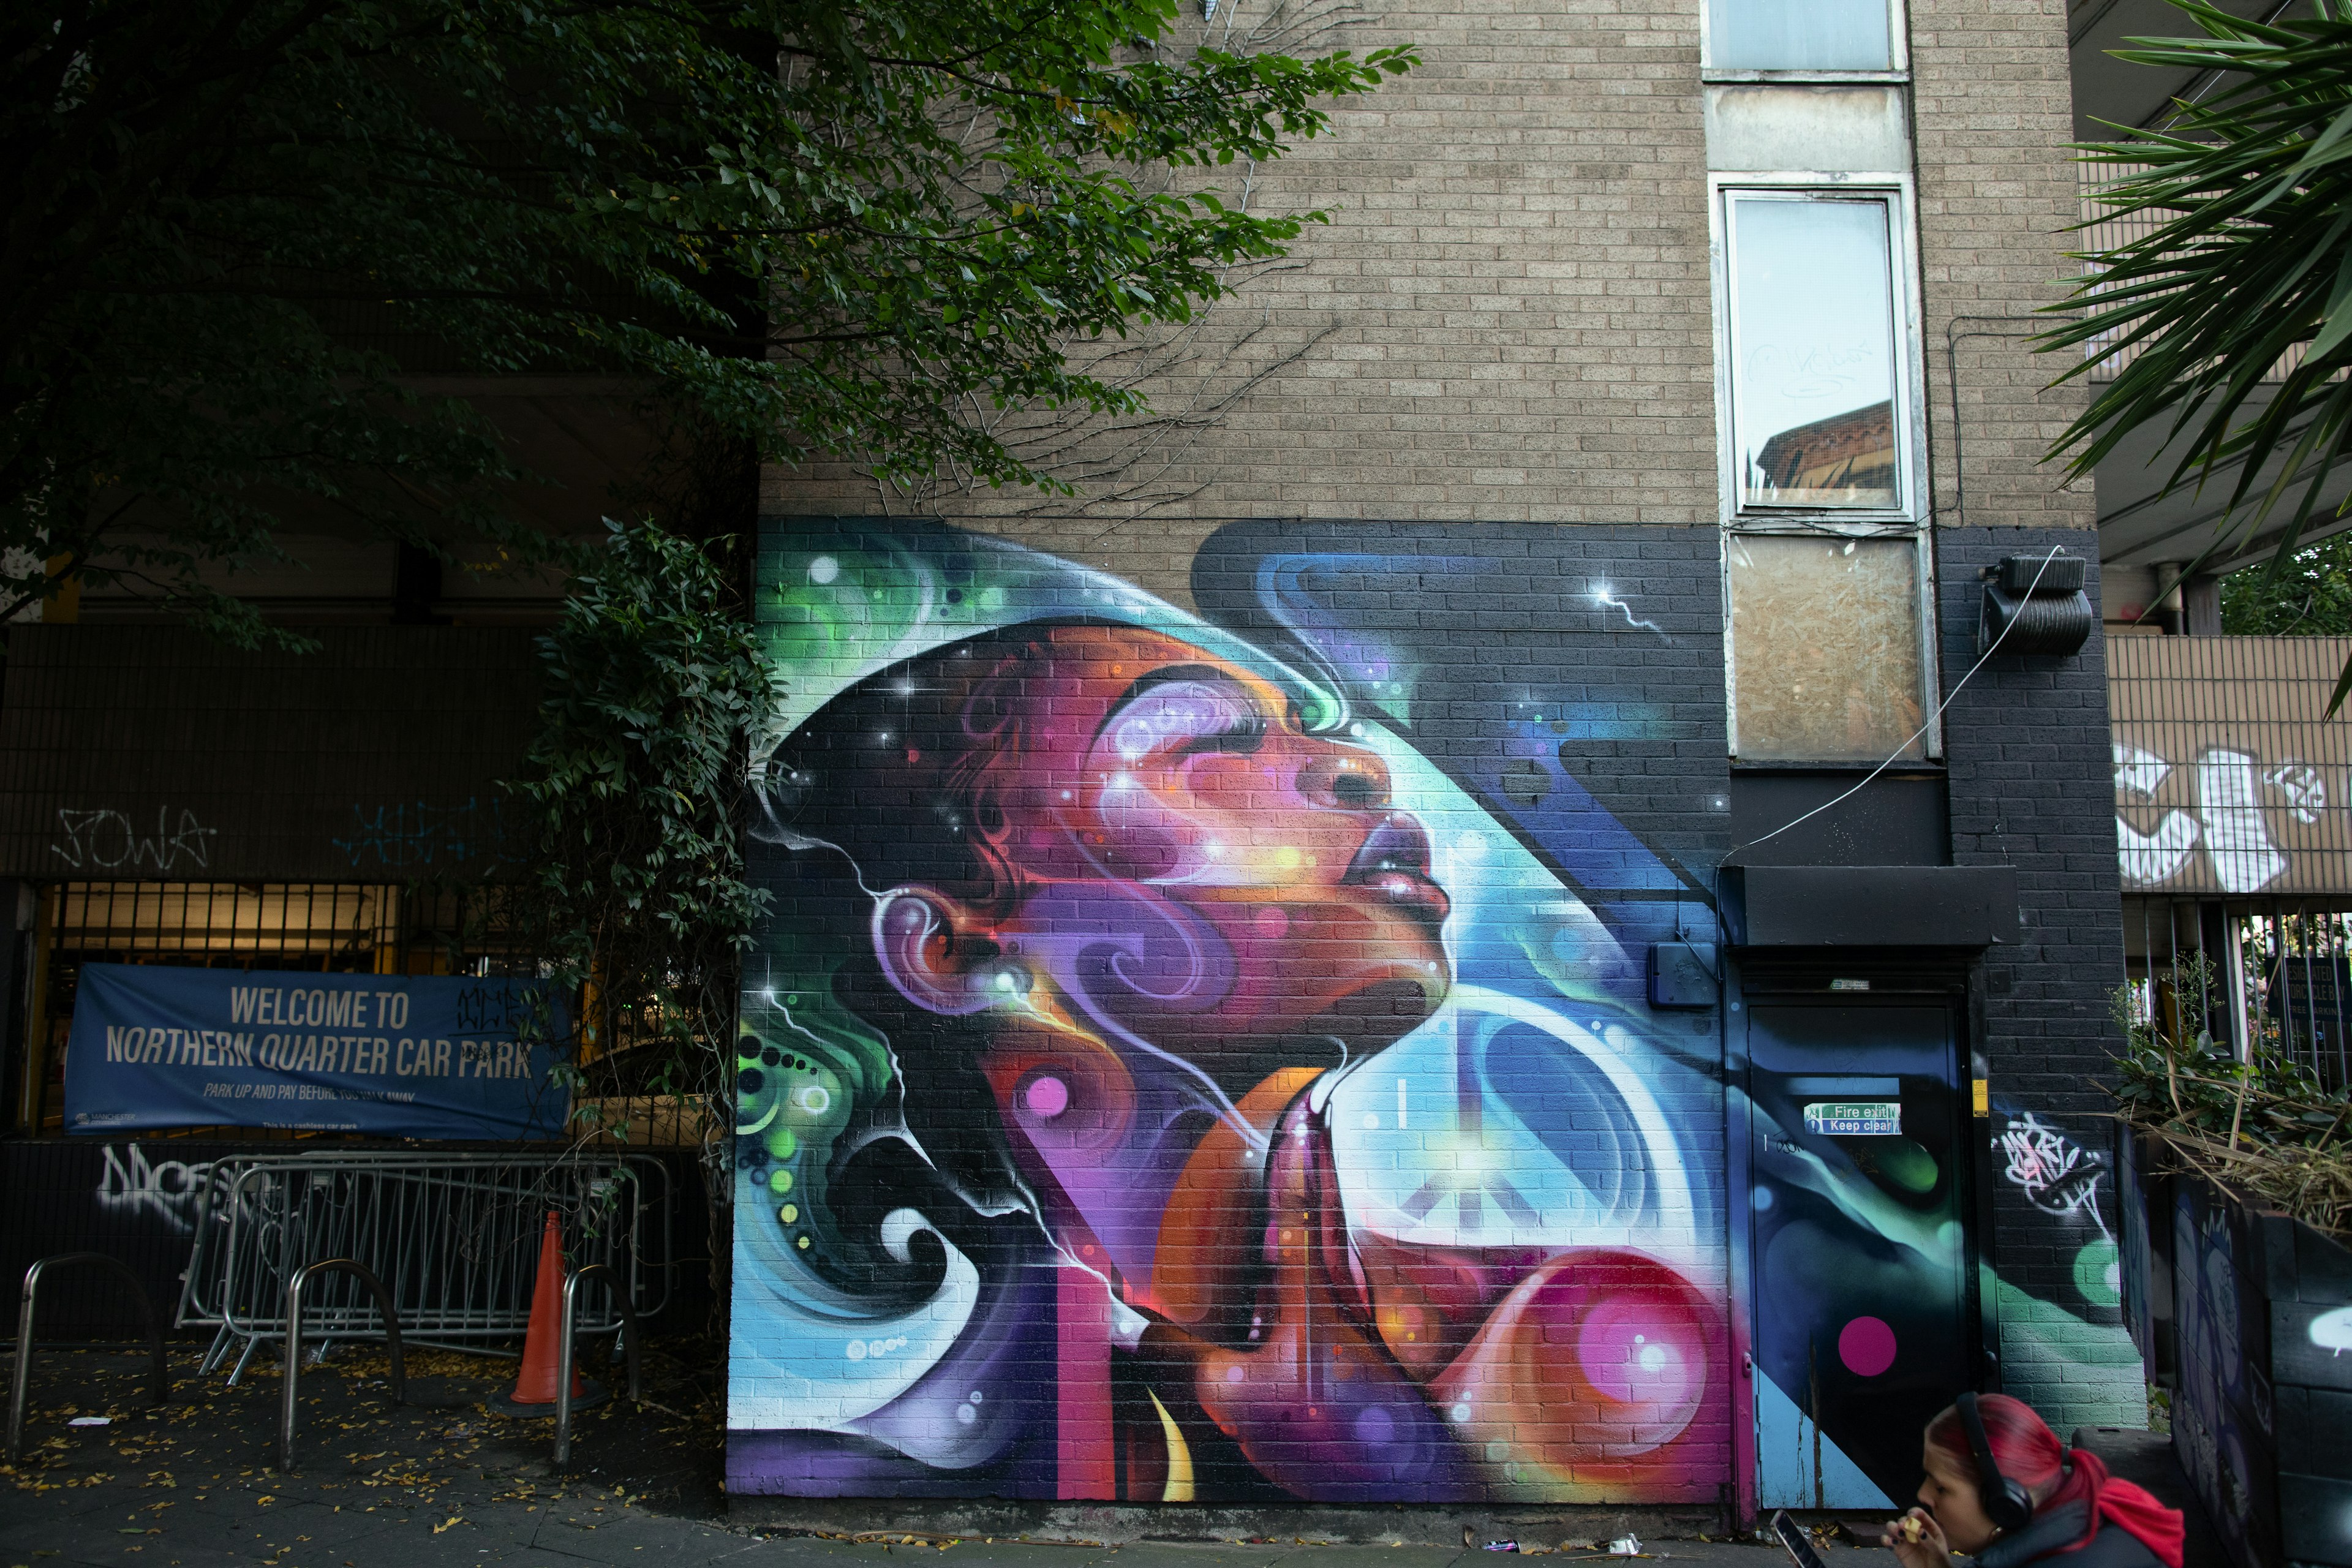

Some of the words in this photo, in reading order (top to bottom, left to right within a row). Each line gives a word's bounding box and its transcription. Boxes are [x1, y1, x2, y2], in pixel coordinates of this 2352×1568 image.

[2329, 985, 2345, 1001] BY
[231, 986, 369, 1028] WELCOME
[375, 991, 409, 1030] TO
[107, 1025, 255, 1067] NORTHERN
[258, 1033, 390, 1075] QUARTER
[396, 1038, 451, 1077] CAR
[458, 1040, 533, 1079] PARK
[203, 1082, 235, 1098] PARK
[235, 1084, 252, 1098] UP
[251, 1084, 276, 1099] AND
[277, 1084, 298, 1100] PAY
[298, 1085, 337, 1101] BEFORE
[1834, 1106, 1860, 1118] Fire
[1863, 1106, 1887, 1118] exit
[340, 1122, 358, 1131] park
[1830, 1120, 1860, 1133] Keep
[1863, 1120, 1891, 1131] clear
